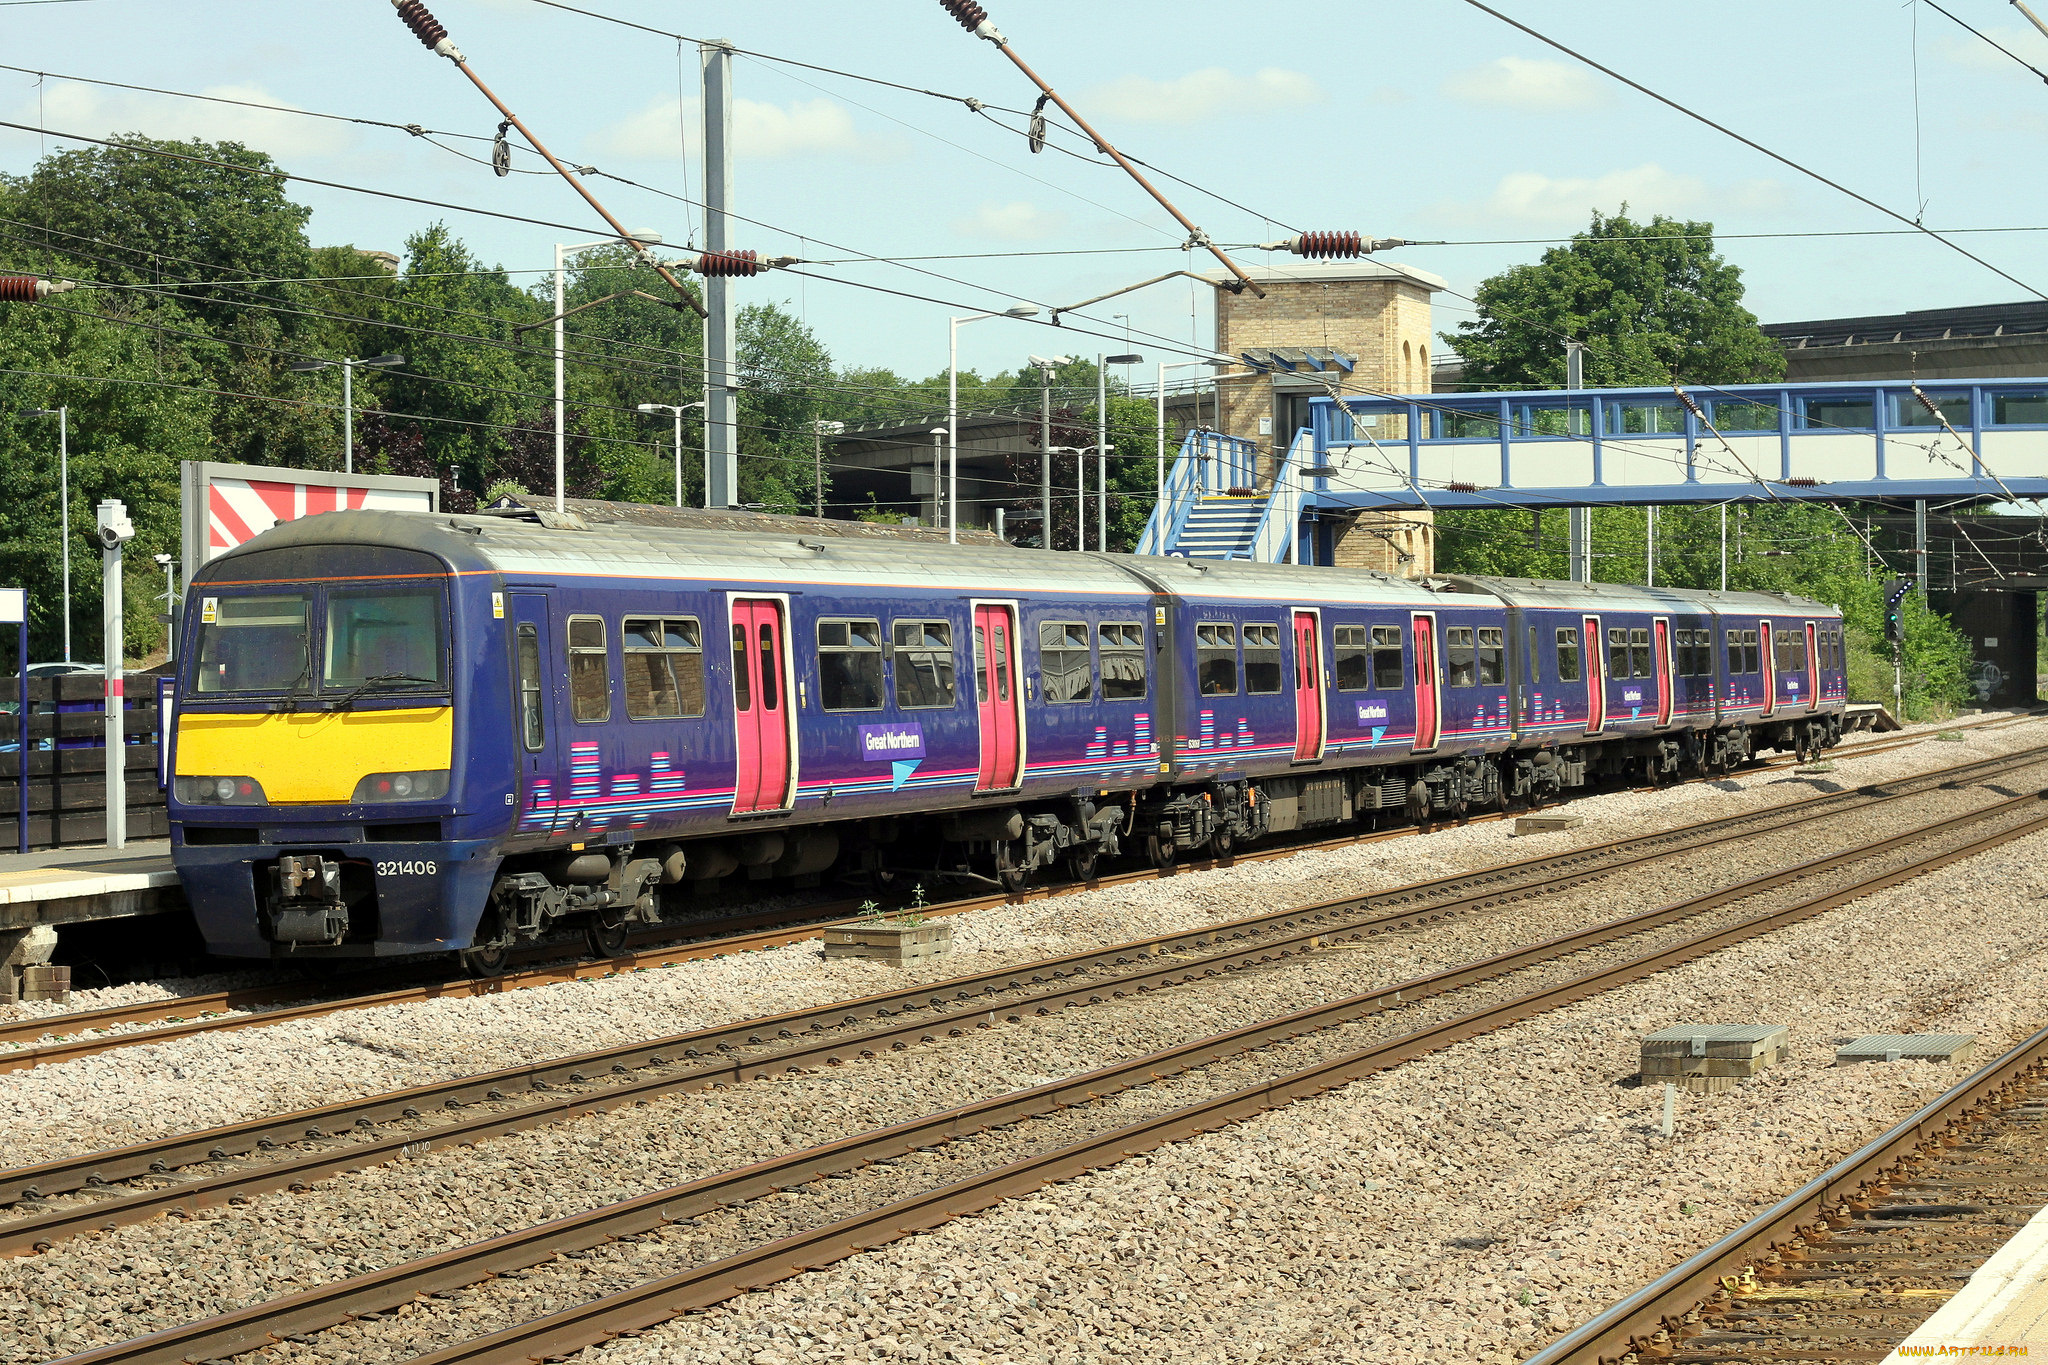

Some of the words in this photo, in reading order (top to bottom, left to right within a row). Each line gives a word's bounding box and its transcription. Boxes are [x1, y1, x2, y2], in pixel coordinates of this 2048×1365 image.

[865, 732, 887, 750] Great
[886, 731, 920, 749] Northern
[376, 861, 437, 876] 321406
